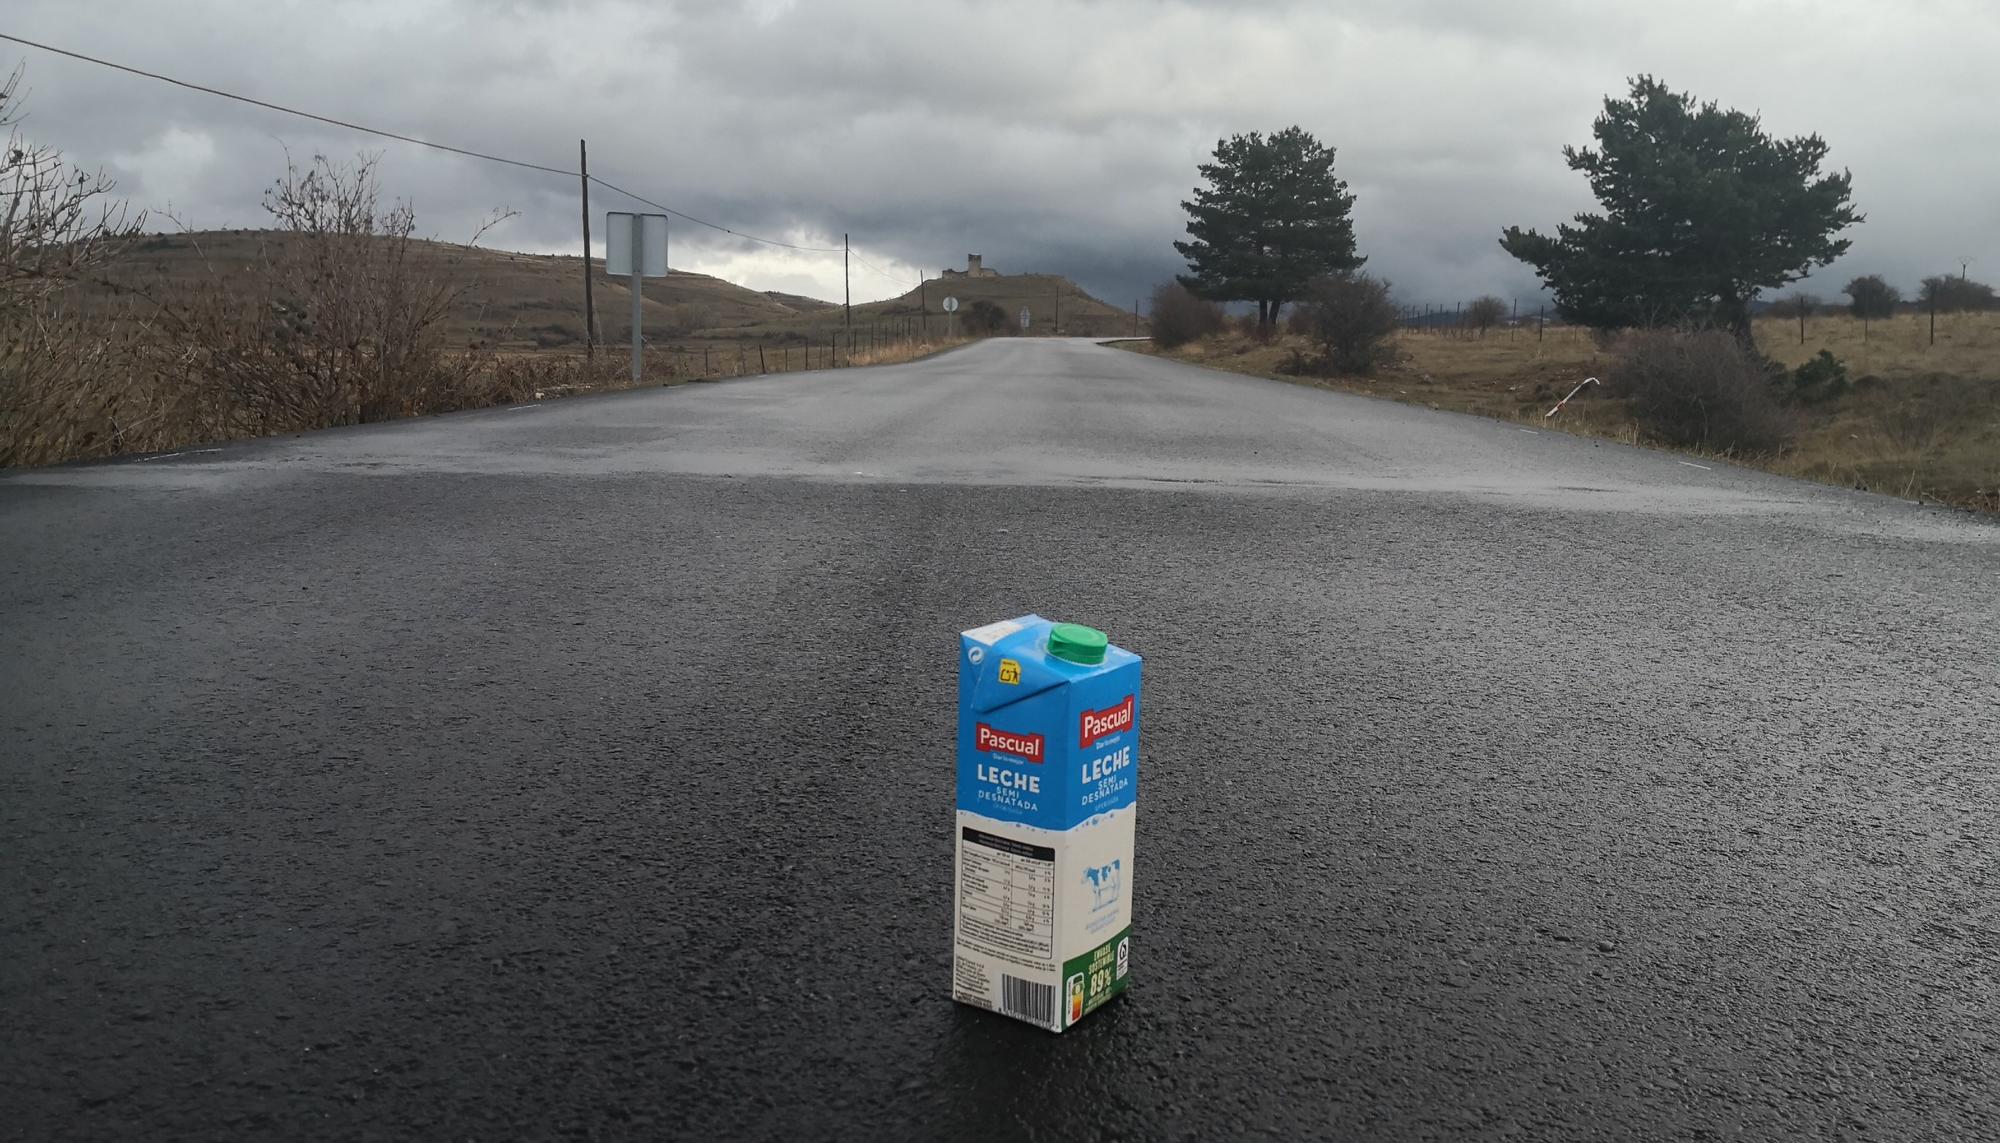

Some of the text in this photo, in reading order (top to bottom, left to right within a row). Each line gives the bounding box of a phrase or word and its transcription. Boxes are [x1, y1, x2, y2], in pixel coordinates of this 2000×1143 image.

[1084, 701, 1132, 738] Pascual
[980, 728, 1040, 756] Pascual
[977, 763, 1041, 794] LECHE
[1082, 746, 1131, 784] LECHE
[996, 785, 1020, 800] SEMI
[1081, 777, 1129, 806] DESNATADA
[1097, 775, 1117, 790] SEMI
[978, 790, 1039, 812] DESNATADA
[1090, 967, 1112, 997] 89%
